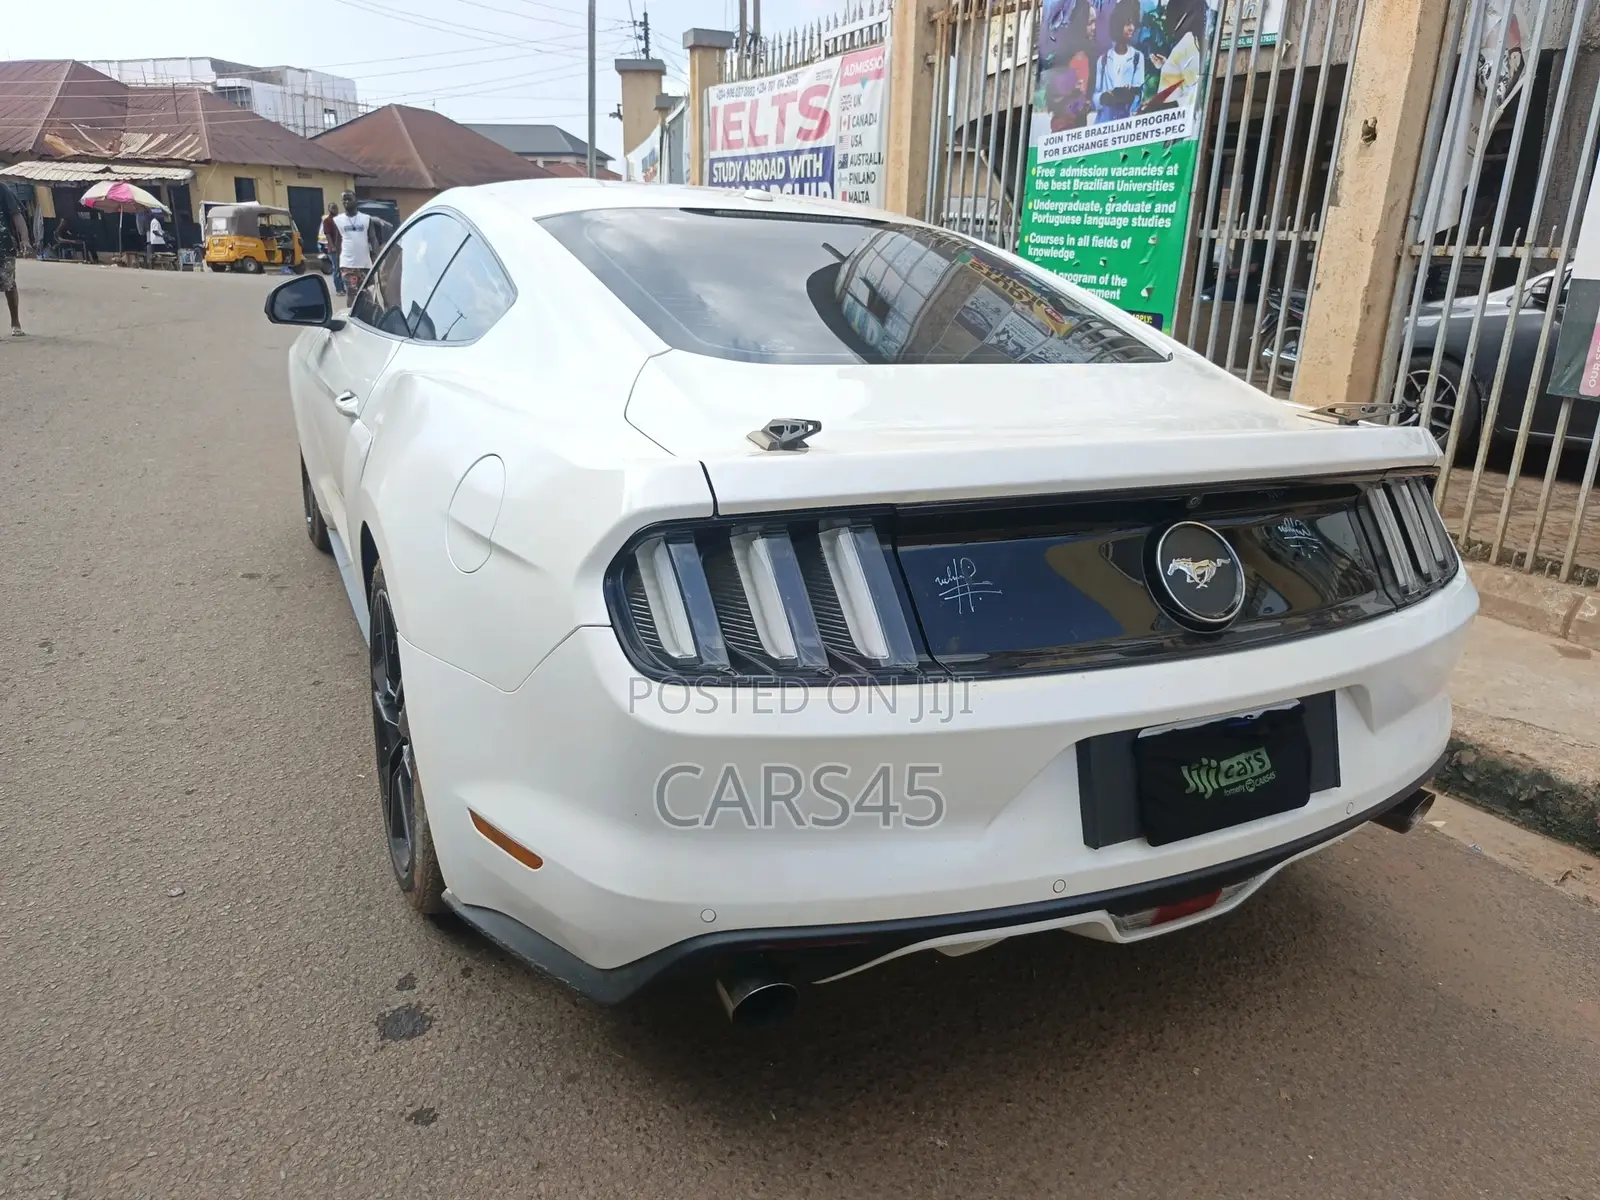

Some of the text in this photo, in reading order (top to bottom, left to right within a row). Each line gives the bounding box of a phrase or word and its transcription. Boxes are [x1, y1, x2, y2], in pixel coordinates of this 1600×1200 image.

[853, 93, 863, 107] UK
[710, 84, 831, 152] IELTS
[1043, 110, 1186, 147] JOIN THE BRAZILIAN PROGRAM
[850, 134, 863, 148] USA
[1043, 123, 1186, 159] FOR EXCHANGE STUDENTS-PEC
[712, 153, 824, 183] STUDY ABROAD WITH
[1036, 163, 1179, 178] Free admission vacancies at
[848, 171, 876, 185] FINLAND
[1035, 178, 1175, 192] the best Brazilian Universities
[848, 190, 870, 203] MALTA
[1033, 199, 1177, 215] Undergraduate, graduate and
[1032, 212, 1172, 229] Portuguese language studies
[1029, 232, 1132, 249] Courses in all fields of
[1028, 245, 1075, 261] knowledge
[1099, 273, 1110, 285] of
[1111, 274, 1128, 287] the
[1588, 362, 1600, 388] OUR
[1223, 751, 1267, 780] cars
